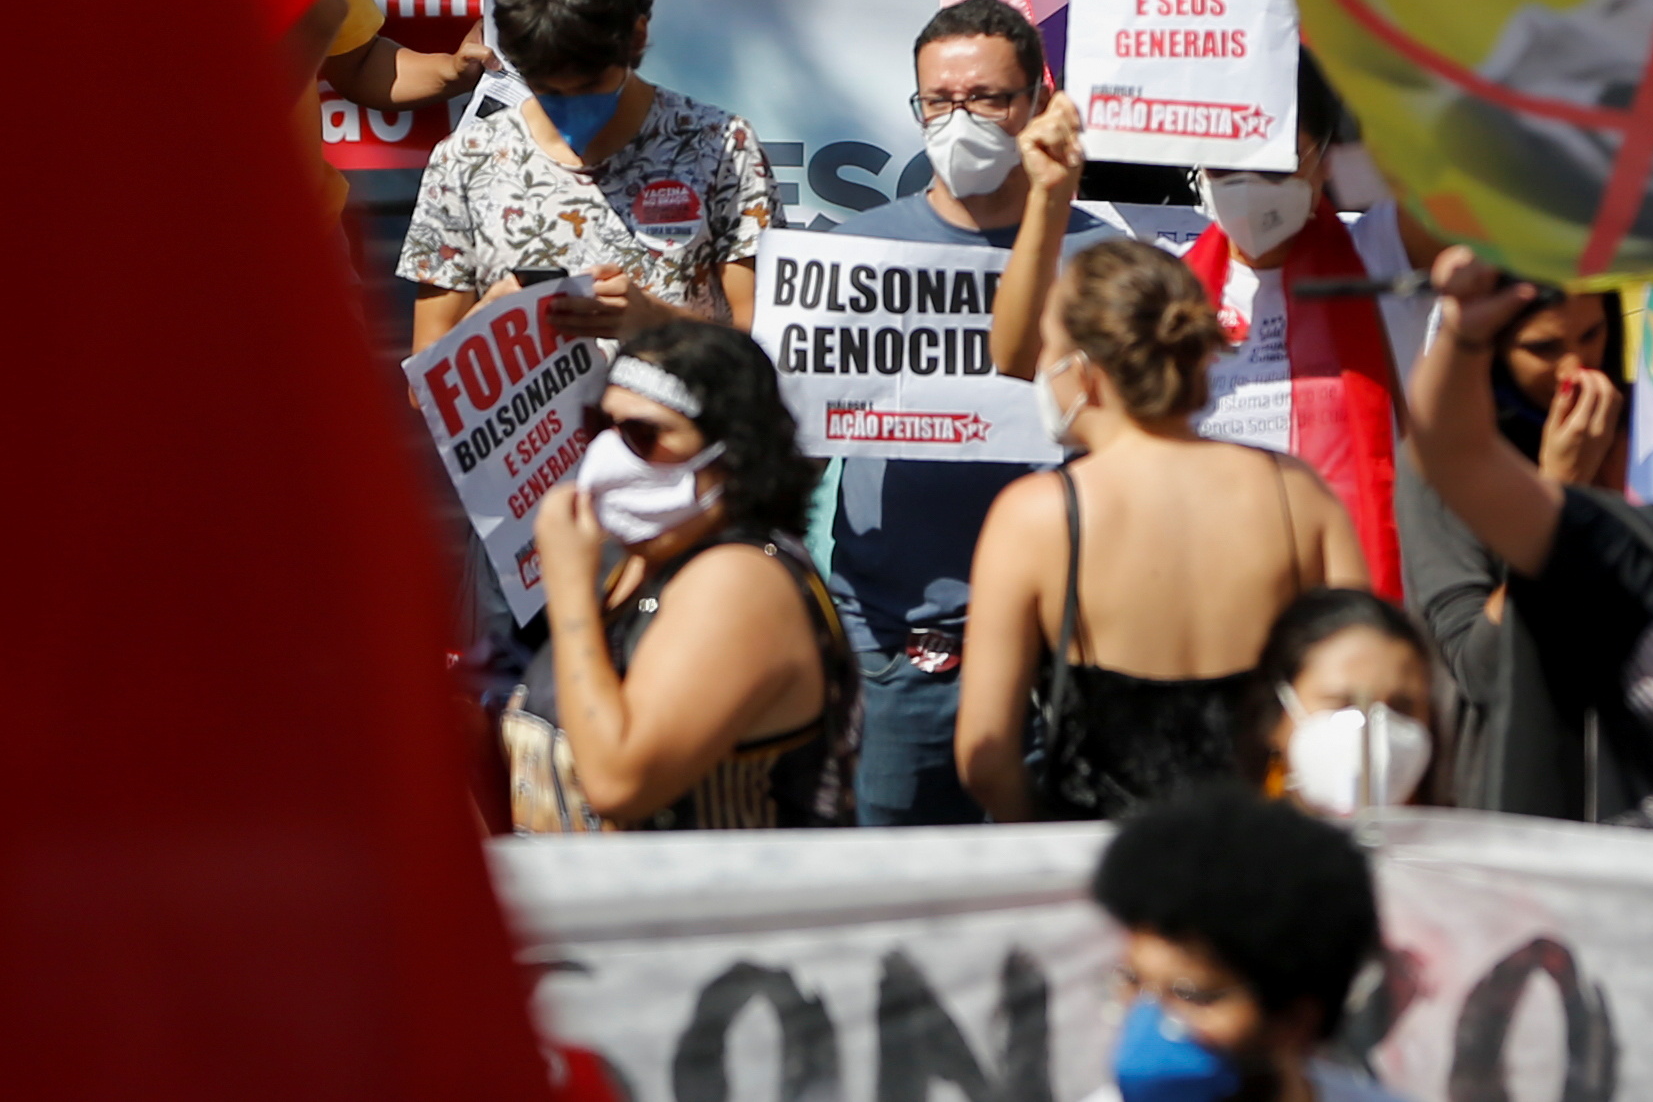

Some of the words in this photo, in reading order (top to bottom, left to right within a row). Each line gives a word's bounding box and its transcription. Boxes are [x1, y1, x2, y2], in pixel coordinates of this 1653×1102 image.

[1115, 29, 1247, 58] GENERAIS
[1091, 100, 1147, 130] AÇÃO
[1152, 102, 1233, 135] PETISTA
[777, 323, 1001, 376] GENOCID
[453, 342, 592, 474] BOLSONARO
[829, 411, 879, 440] AÇÃO
[881, 415, 955, 439] PETISTA
[503, 454, 518, 478] E
[516, 409, 563, 465] SEUS
[507, 428, 589, 520] GENERAIS
